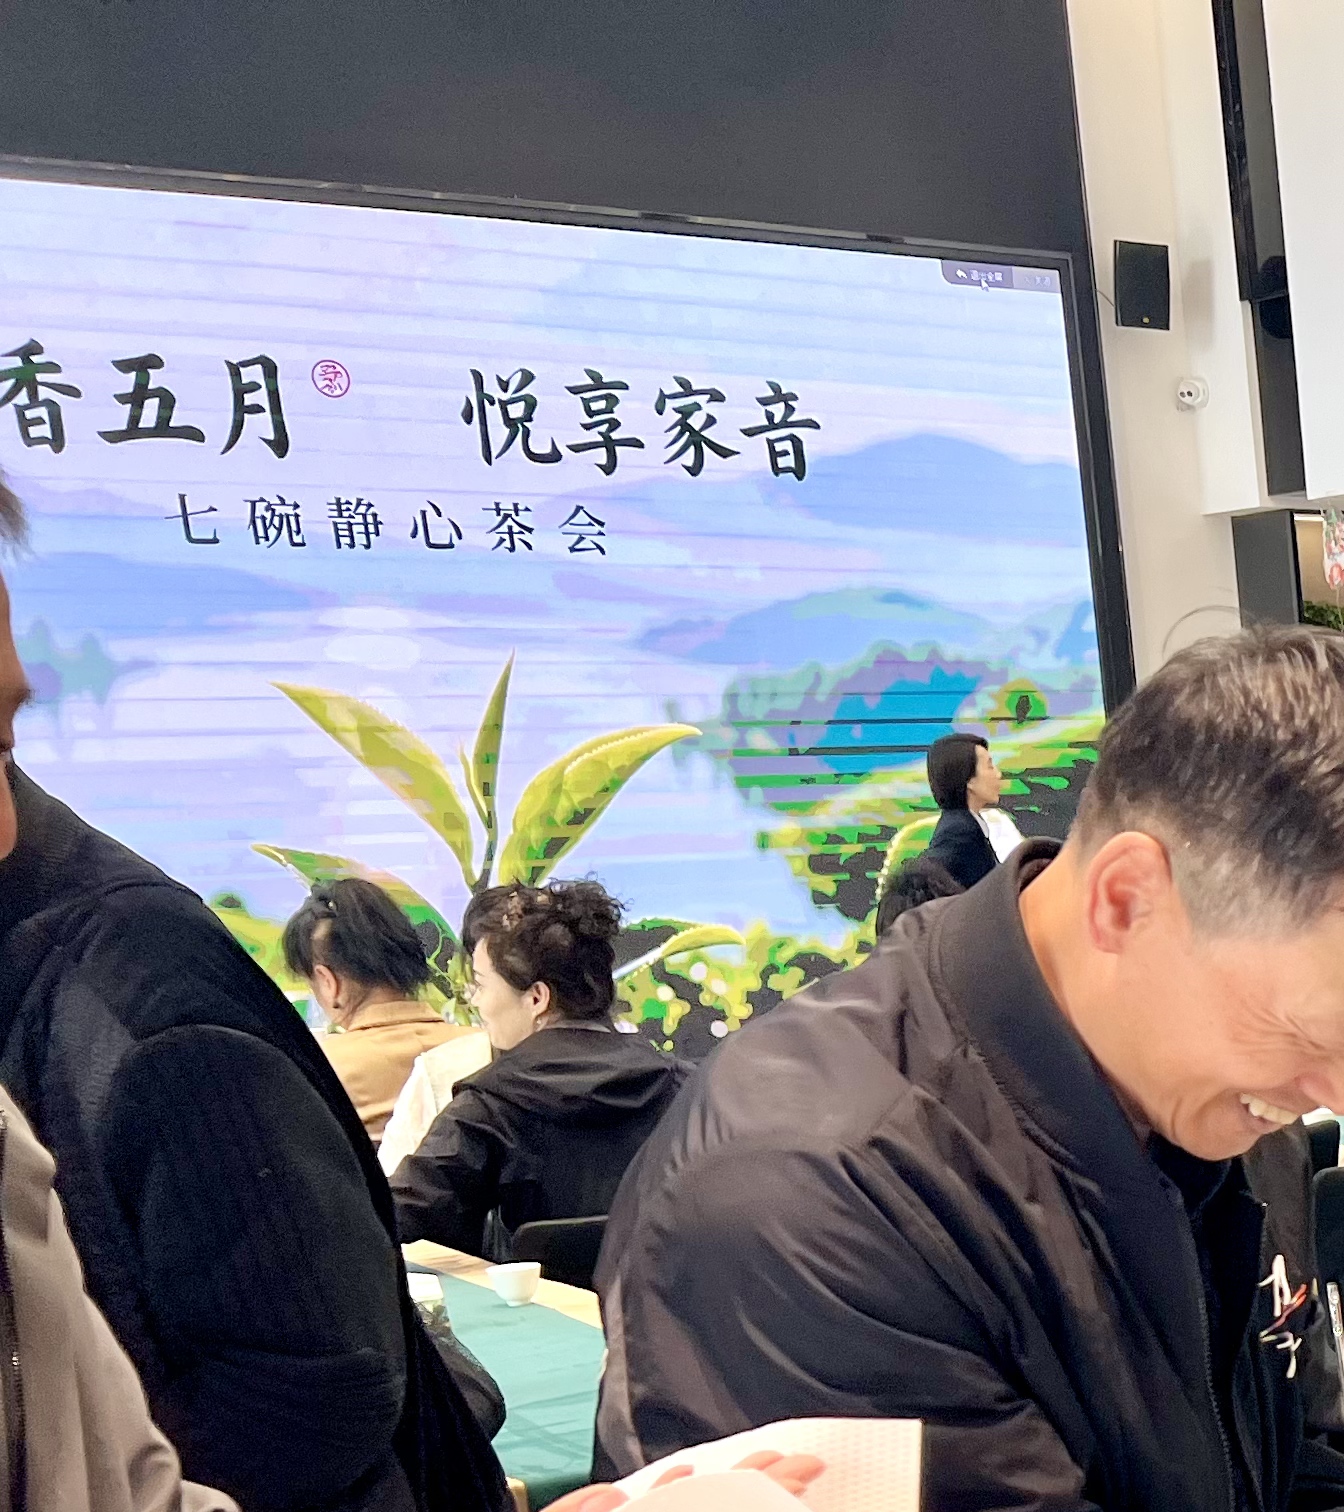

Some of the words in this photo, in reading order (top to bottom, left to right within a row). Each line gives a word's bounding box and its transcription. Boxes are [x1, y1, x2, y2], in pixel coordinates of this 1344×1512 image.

[0, 337, 290, 459] 香五月
[460, 367, 821, 482] 悦享家音
[164, 492, 606, 556] 七碗静心茶会
